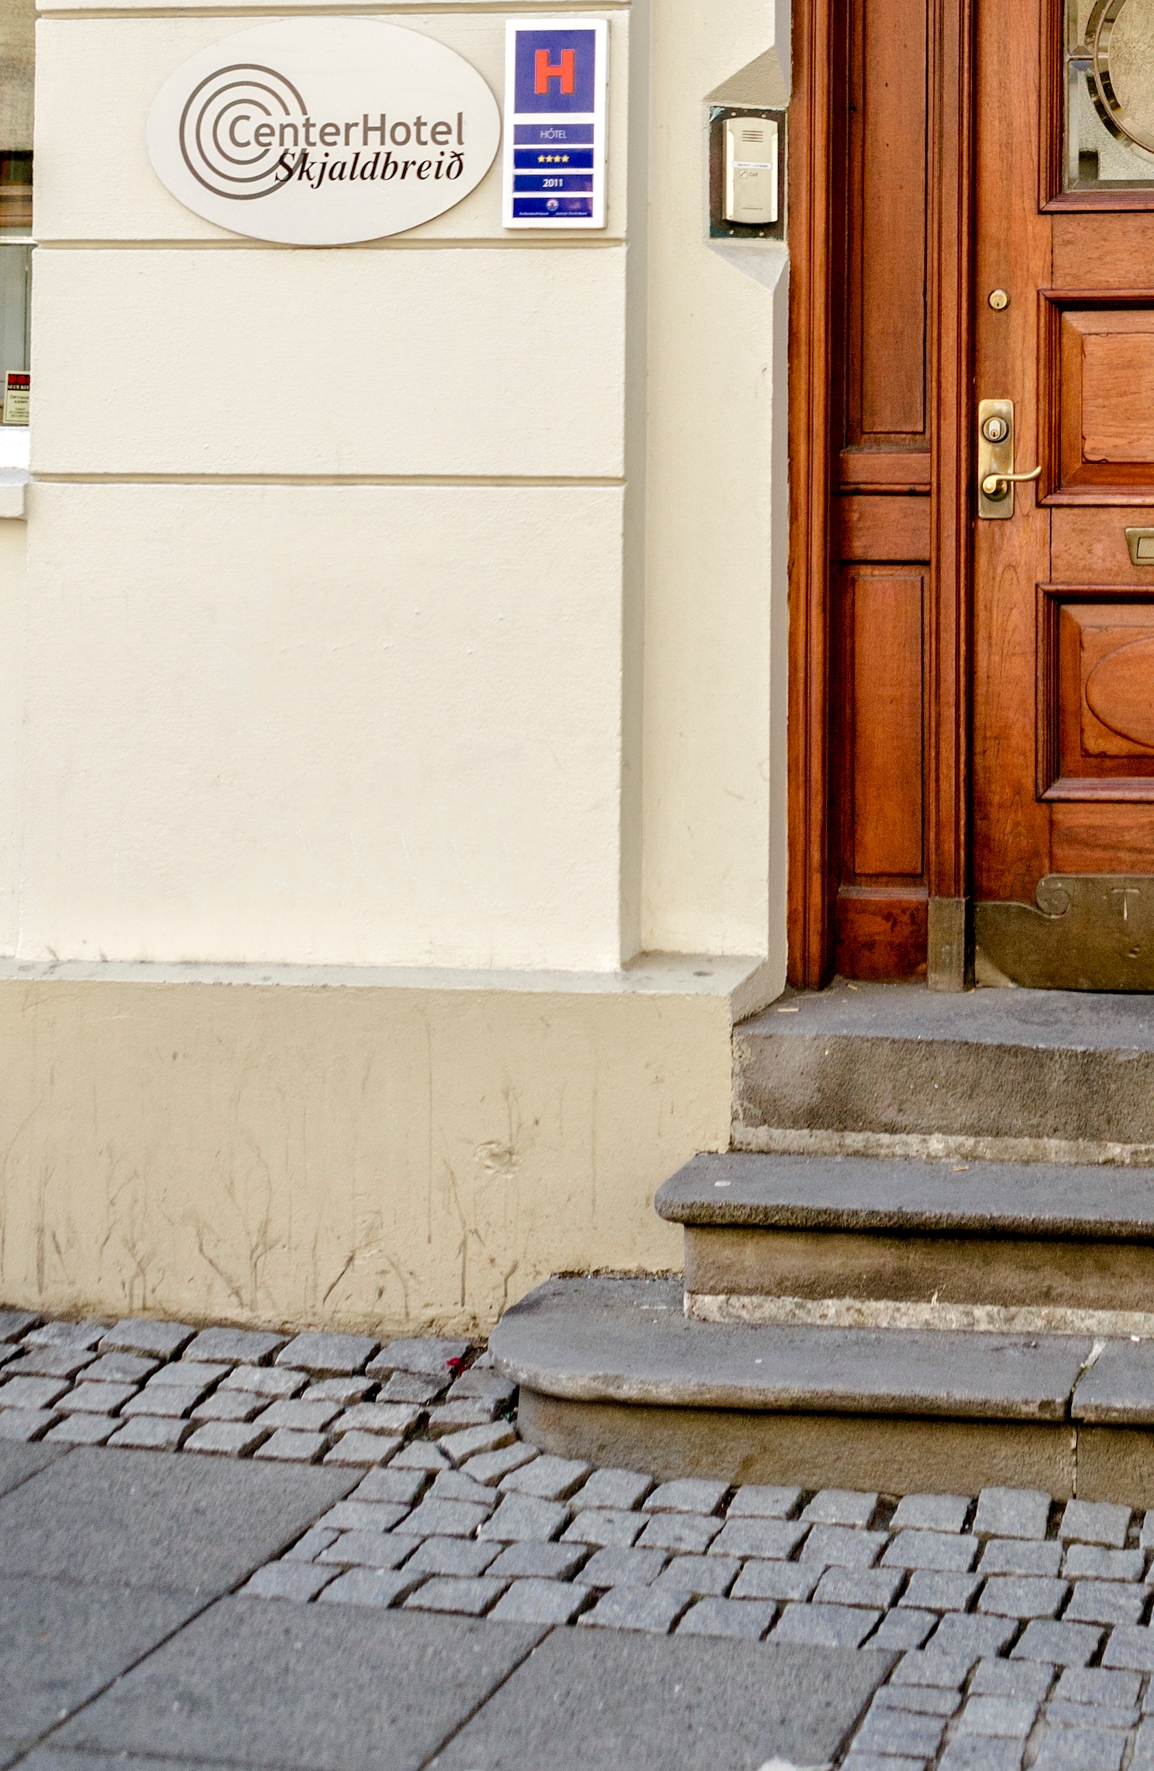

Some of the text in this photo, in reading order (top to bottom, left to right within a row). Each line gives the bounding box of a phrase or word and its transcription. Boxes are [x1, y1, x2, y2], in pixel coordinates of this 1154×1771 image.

[534, 48, 576, 95] H
[228, 111, 466, 148] CenterHotel
[540, 127, 567, 139] HÓTEL
[274, 150, 466, 190] Skjaldbreið
[542, 178, 563, 188] 2011
